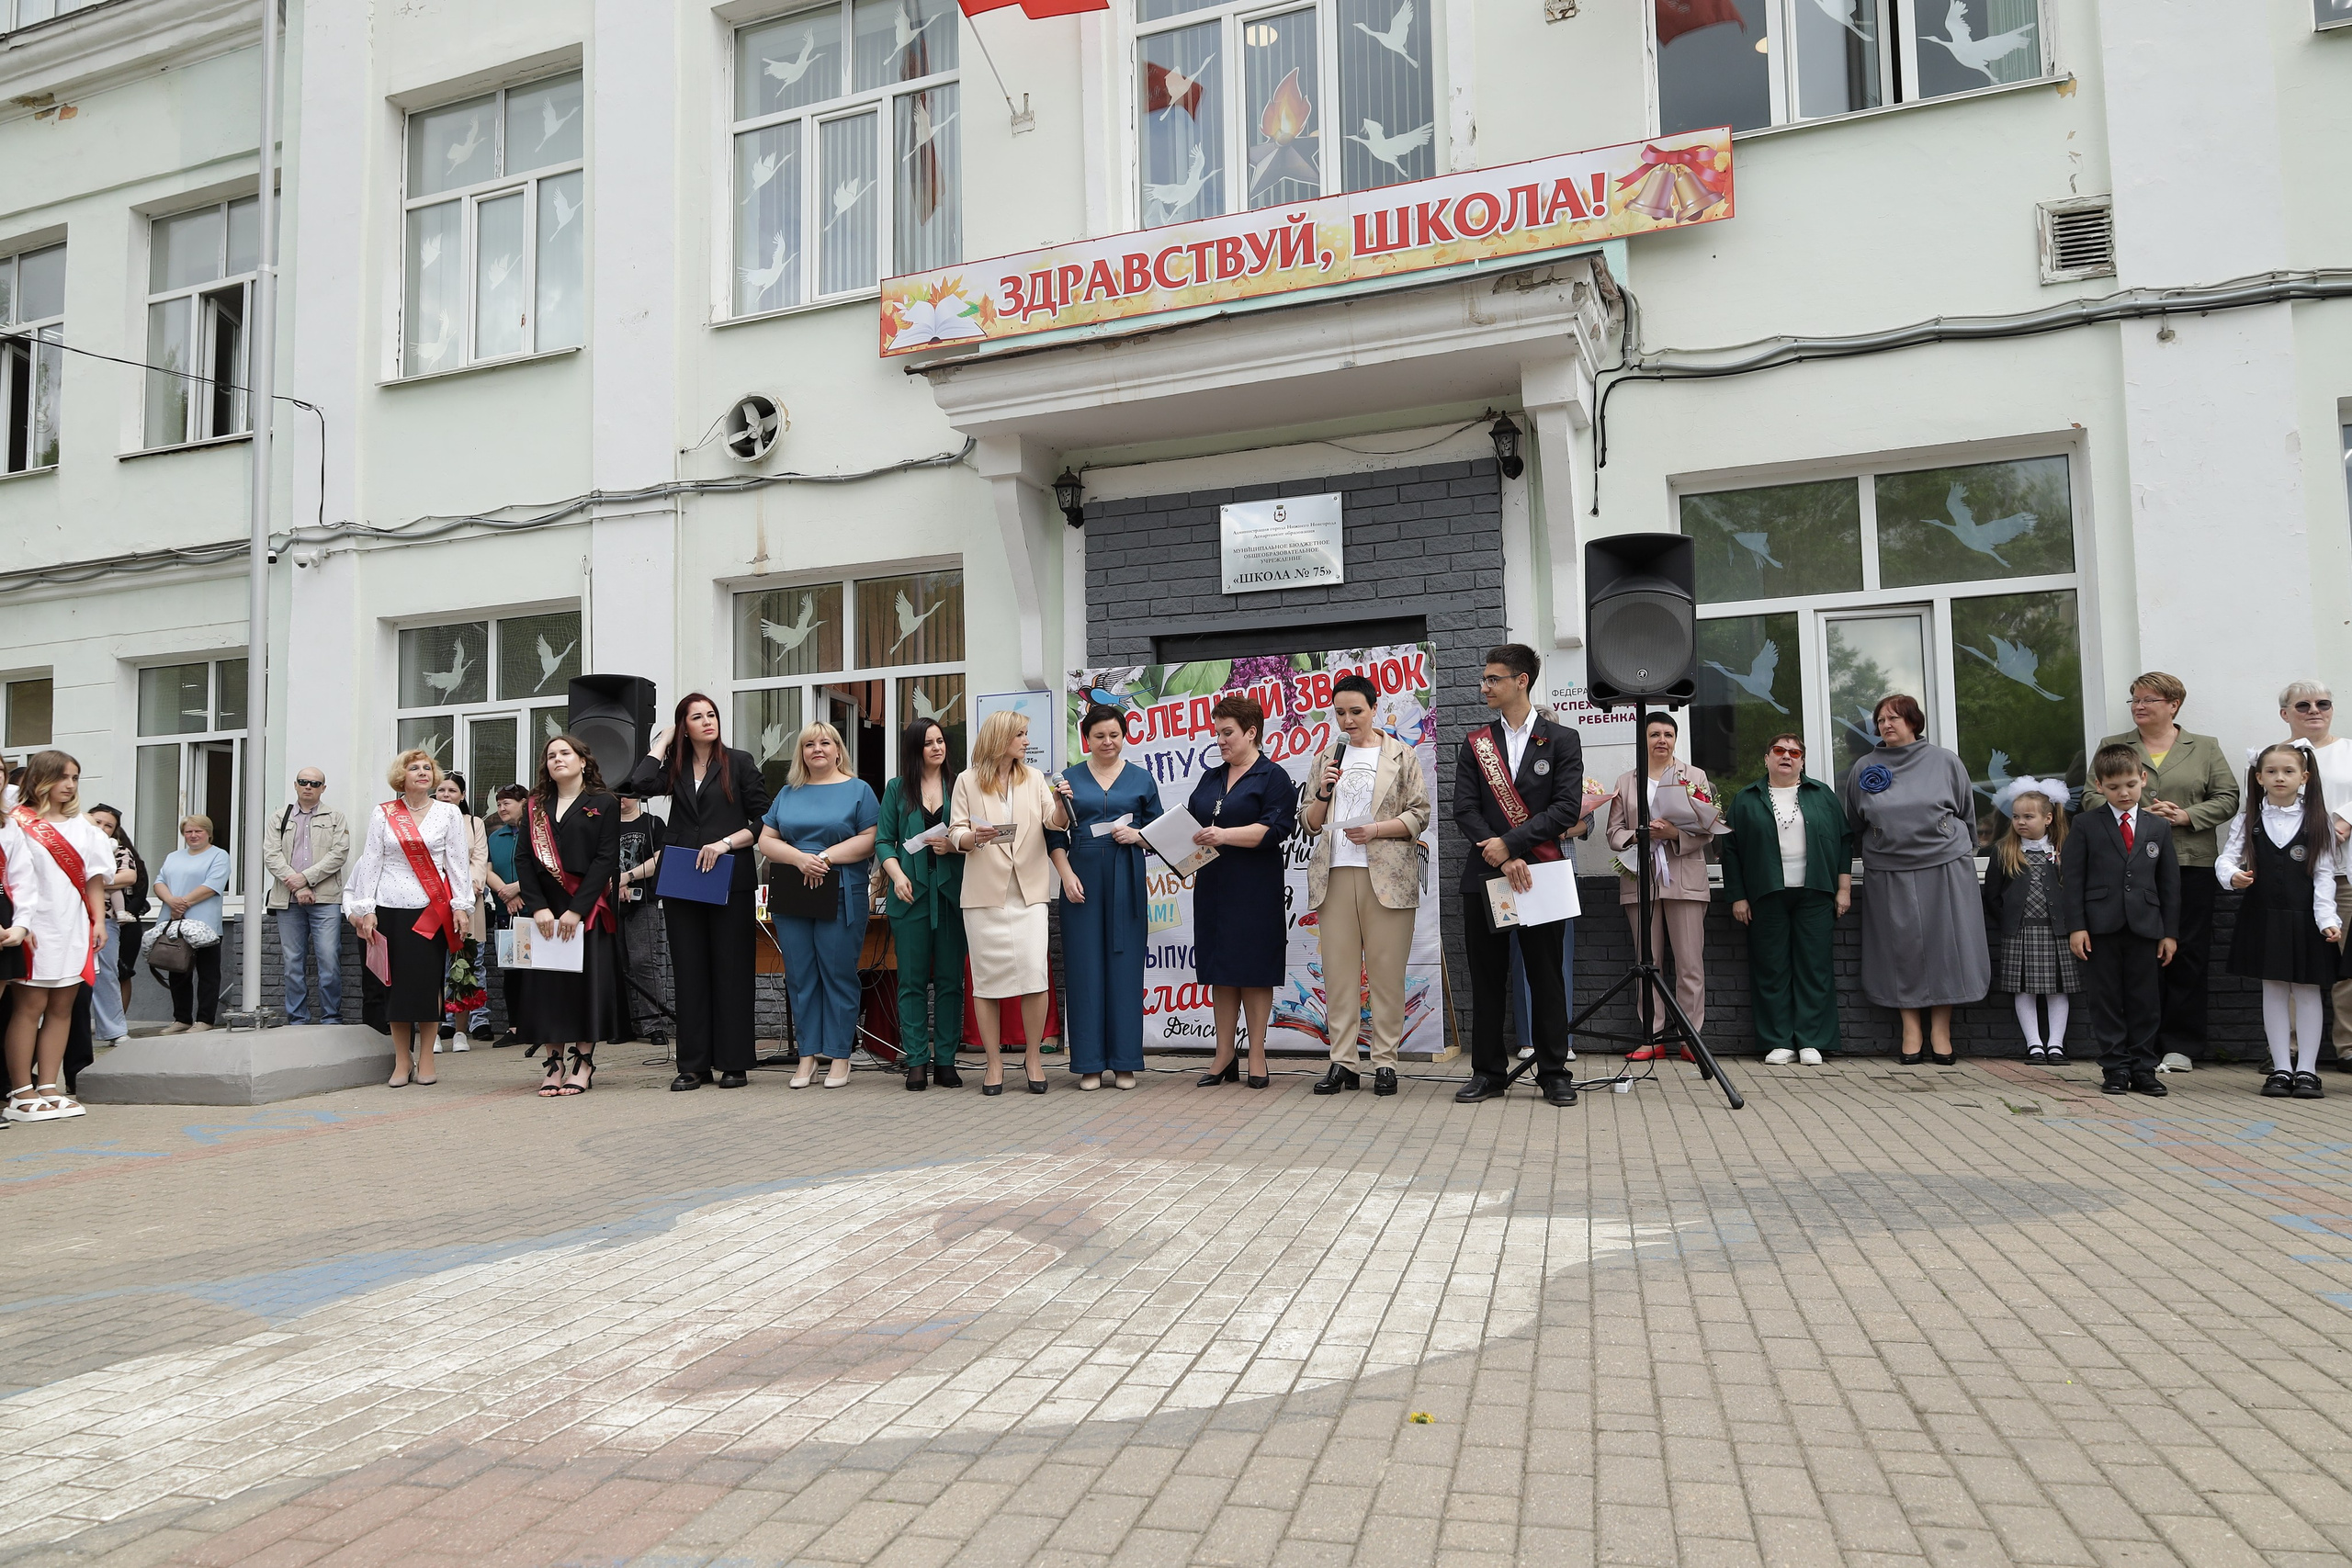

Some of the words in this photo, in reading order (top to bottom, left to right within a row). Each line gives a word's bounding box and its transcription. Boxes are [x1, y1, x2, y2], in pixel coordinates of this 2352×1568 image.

[998, 212, 1332, 322] ЗДРАВСТВУЙ,
[1352, 172, 1606, 258] ШКОЛА!
[1233, 545, 1288, 554] МУНИЦИПАЛЬНОЕ
[1288, 540, 1330, 548] БЮДЖЕТНОЕ
[1243, 547, 1319, 559] ОБЩЕОБРАЗОВАТЕЛЬНОЕ
[1260, 556, 1303, 564] УЧРЕЖДЕНИЕ
[1233, 570, 1291, 584] «ШКОЛА
[1294, 568, 1310, 579] №
[1313, 567, 1332, 577] 75»
[1295, 653, 1428, 713] ЗВНОК
[1551, 687, 1589, 697] ФЕДЕРА
[1553, 701, 1593, 712] УСПЕХ
[1578, 713, 1637, 725] РЕБЕНКА
[1265, 722, 1331, 763] 202
